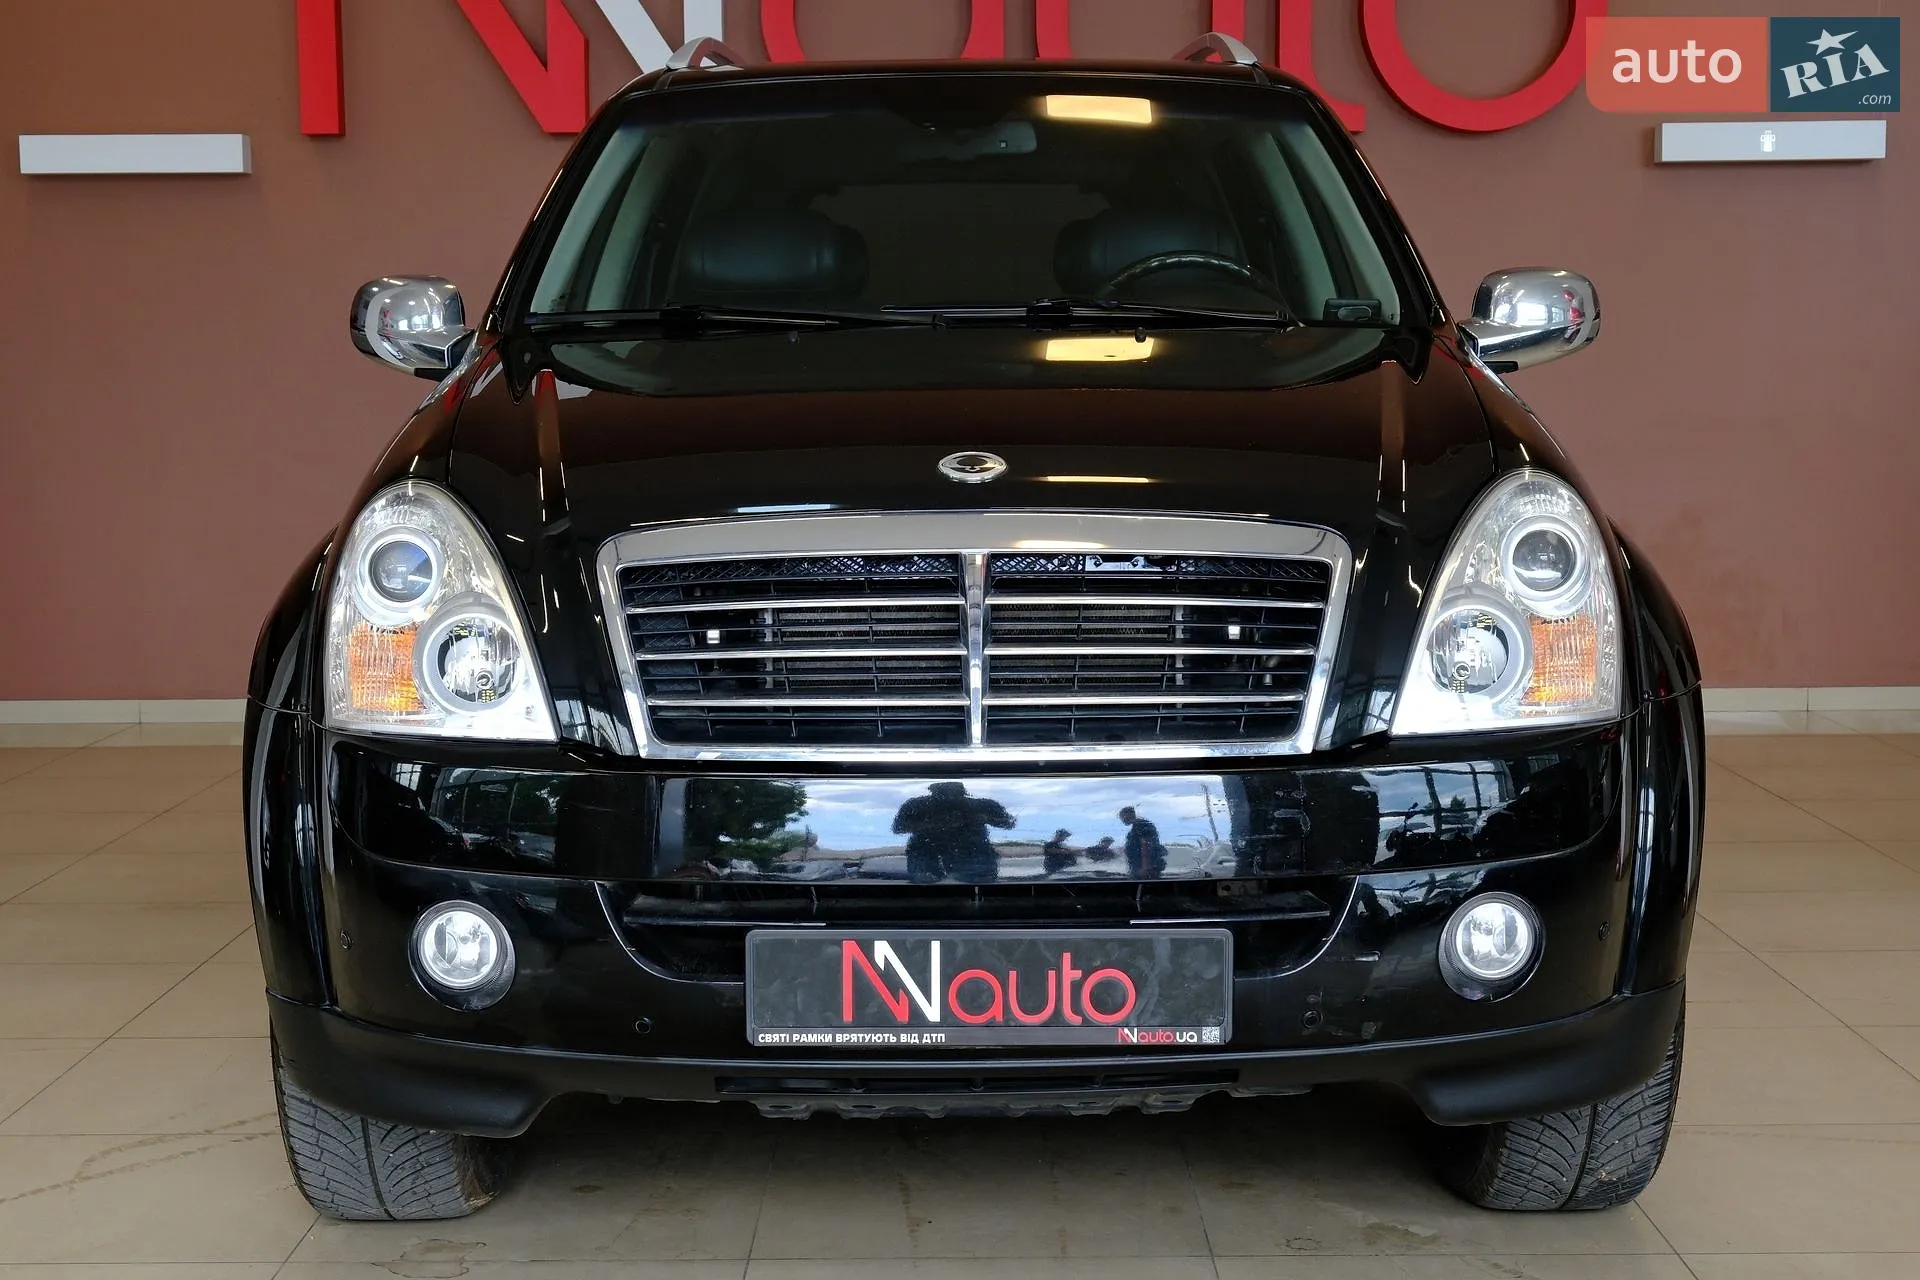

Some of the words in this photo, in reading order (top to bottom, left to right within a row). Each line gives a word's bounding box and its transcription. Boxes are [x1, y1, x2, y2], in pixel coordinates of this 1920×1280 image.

[758, 1033, 790, 1043] СВЯТІ
[792, 1033, 833, 1043] РАМКИ
[835, 1033, 897, 1043] ВРЯТУЮТЬ
[900, 1033, 920, 1044] ВІД
[922, 1033, 946, 1044] ДТП
